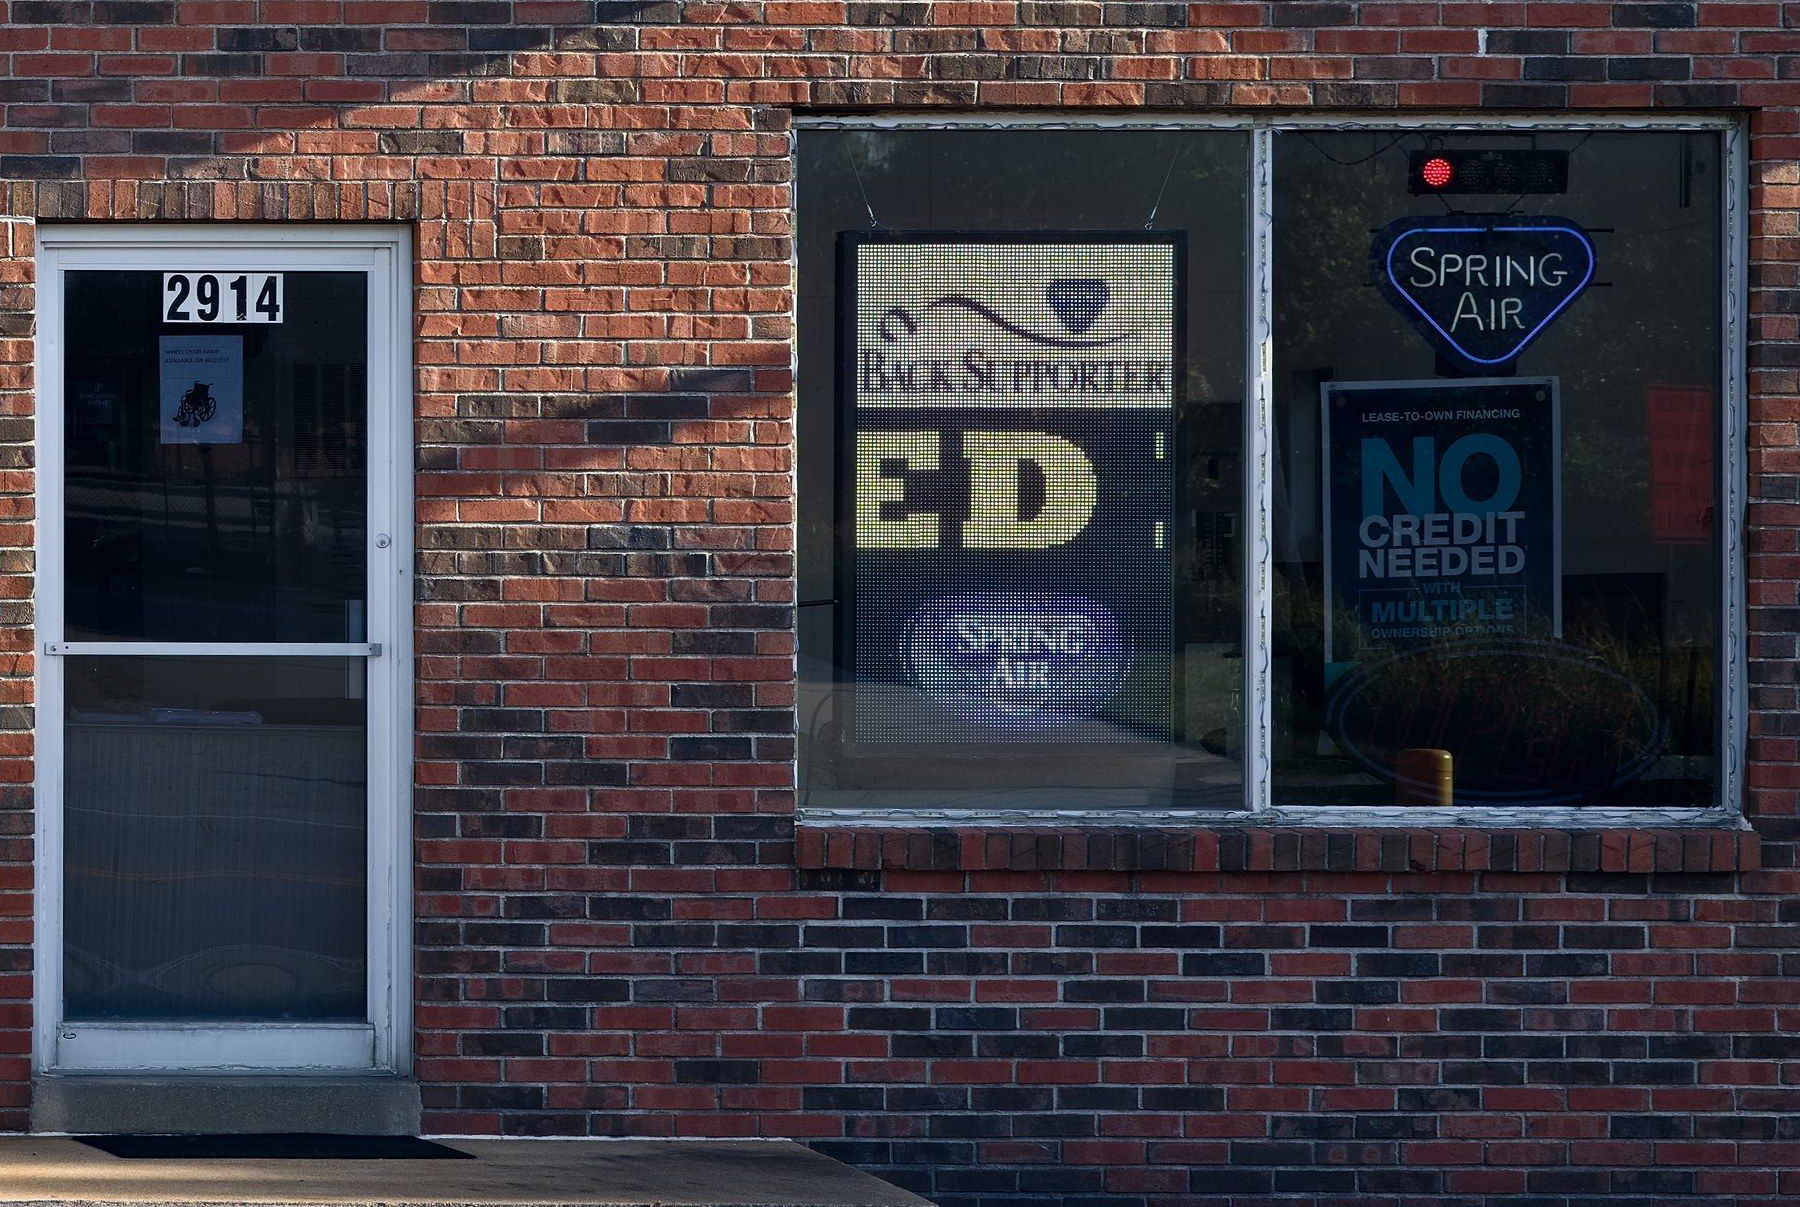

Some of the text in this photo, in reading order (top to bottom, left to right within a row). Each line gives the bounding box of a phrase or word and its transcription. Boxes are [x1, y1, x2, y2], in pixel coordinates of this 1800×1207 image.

[1410, 246, 1568, 288] SPRING
[166, 273, 281, 322] 2914
[1450, 291, 1526, 332] AIR
[963, 349, 1167, 394] SUPPORTER
[1362, 408, 1521, 423] LEASE-TO-OWN FINANCING
[1360, 433, 1522, 520] NO
[1358, 511, 1526, 548] CREDIT
[1358, 545, 1526, 579] NEEDED
[1422, 581, 1462, 594] WITH
[1371, 598, 1514, 623] MULTIPLE
[1371, 624, 1514, 639] OWNERSHIP OPTIONS
